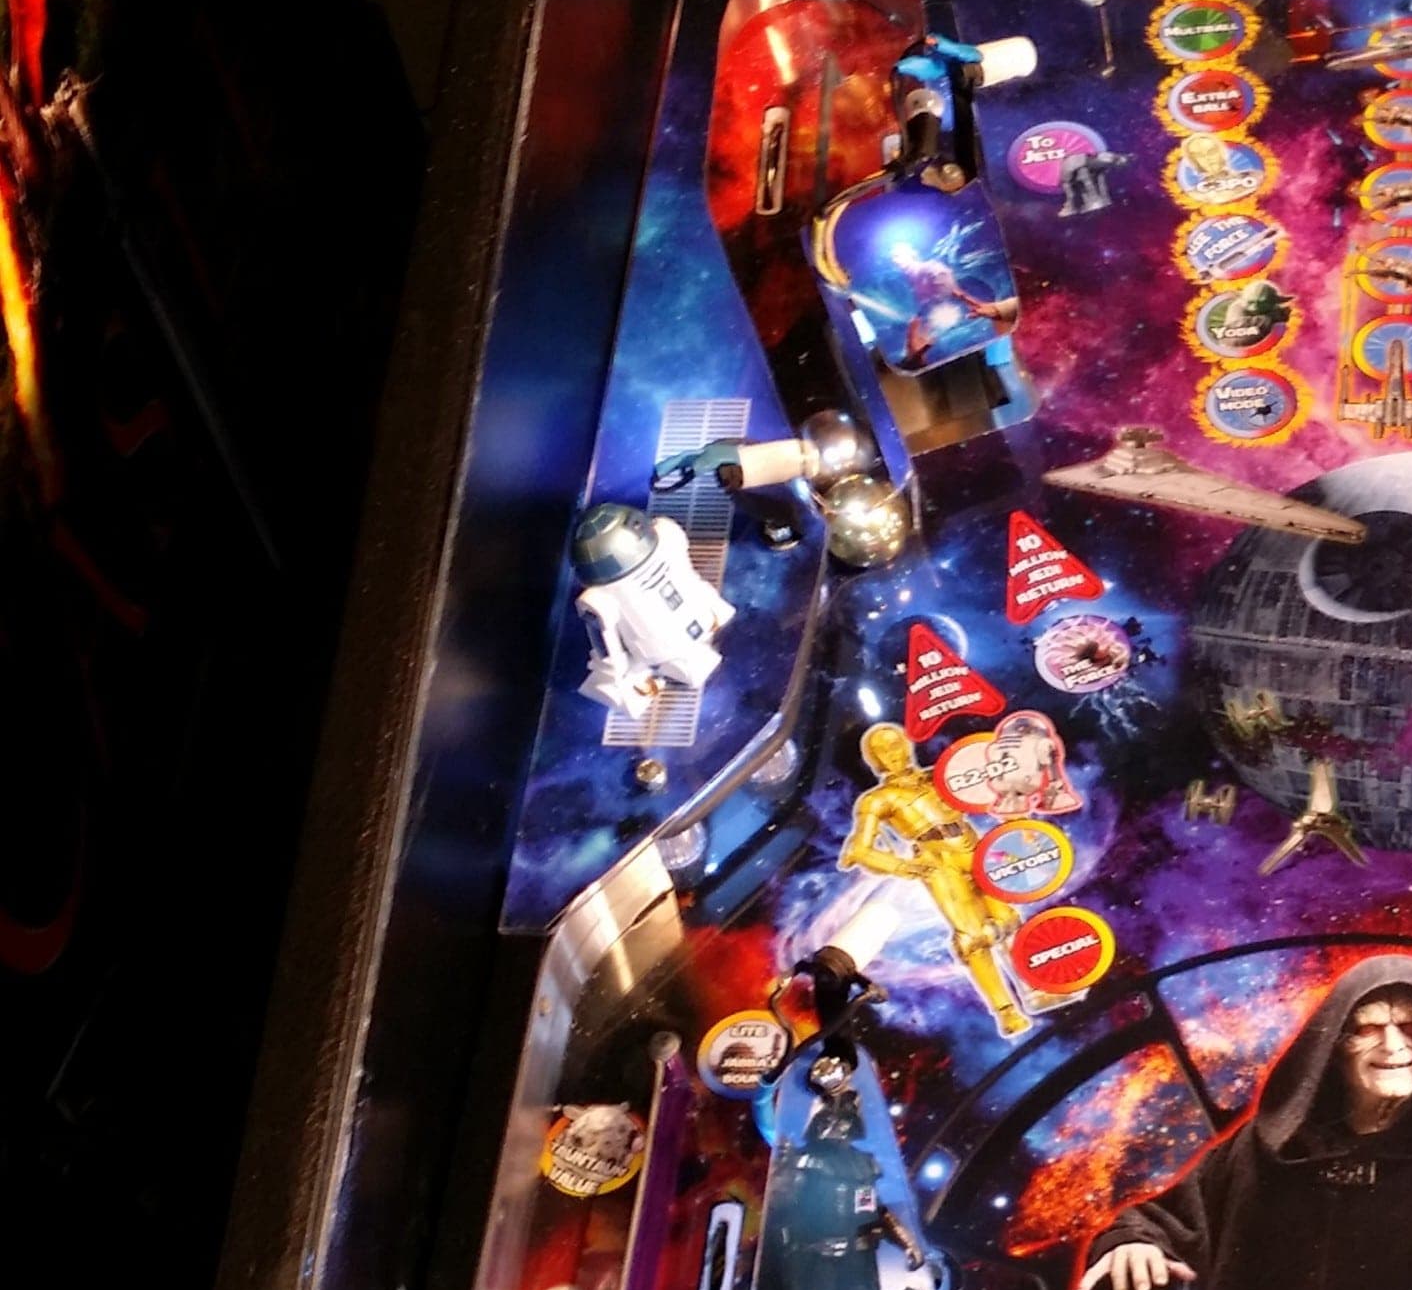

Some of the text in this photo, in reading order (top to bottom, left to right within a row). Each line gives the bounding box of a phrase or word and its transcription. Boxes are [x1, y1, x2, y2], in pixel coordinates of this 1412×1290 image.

[1163, 22, 1239, 38] MULTIBALL
[1181, 89, 1239, 104] EXTRA
[1192, 102, 1231, 114] BALL
[1197, 175, 1258, 193] C-3PO
[1187, 215, 1249, 256] USE THE
[1203, 229, 1250, 260] FORCE
[1212, 326, 1260, 340] YODA
[1215, 385, 1269, 400] VIDEO
[1219, 398, 1266, 411] MODE
[1017, 533, 1043, 553] 10
[1009, 549, 1069, 577] MILLION
[1027, 564, 1063, 584] JEDI
[1015, 574, 1085, 605] RETURN
[918, 651, 944, 669] 10
[1061, 658, 1094, 676] THE
[909, 665, 970, 695] MILLION
[928, 681, 962, 701] JEDI
[918, 692, 983, 721] RETURN
[946, 758, 1021, 792] R2-D2
[988, 846, 1060, 882] VICTORY
[1028, 933, 1100, 969] SPECIAL
[730, 1026, 767, 1037] LITE
[722, 1072, 759, 1085] BOUN
[549, 1163, 600, 1194] VALUE
